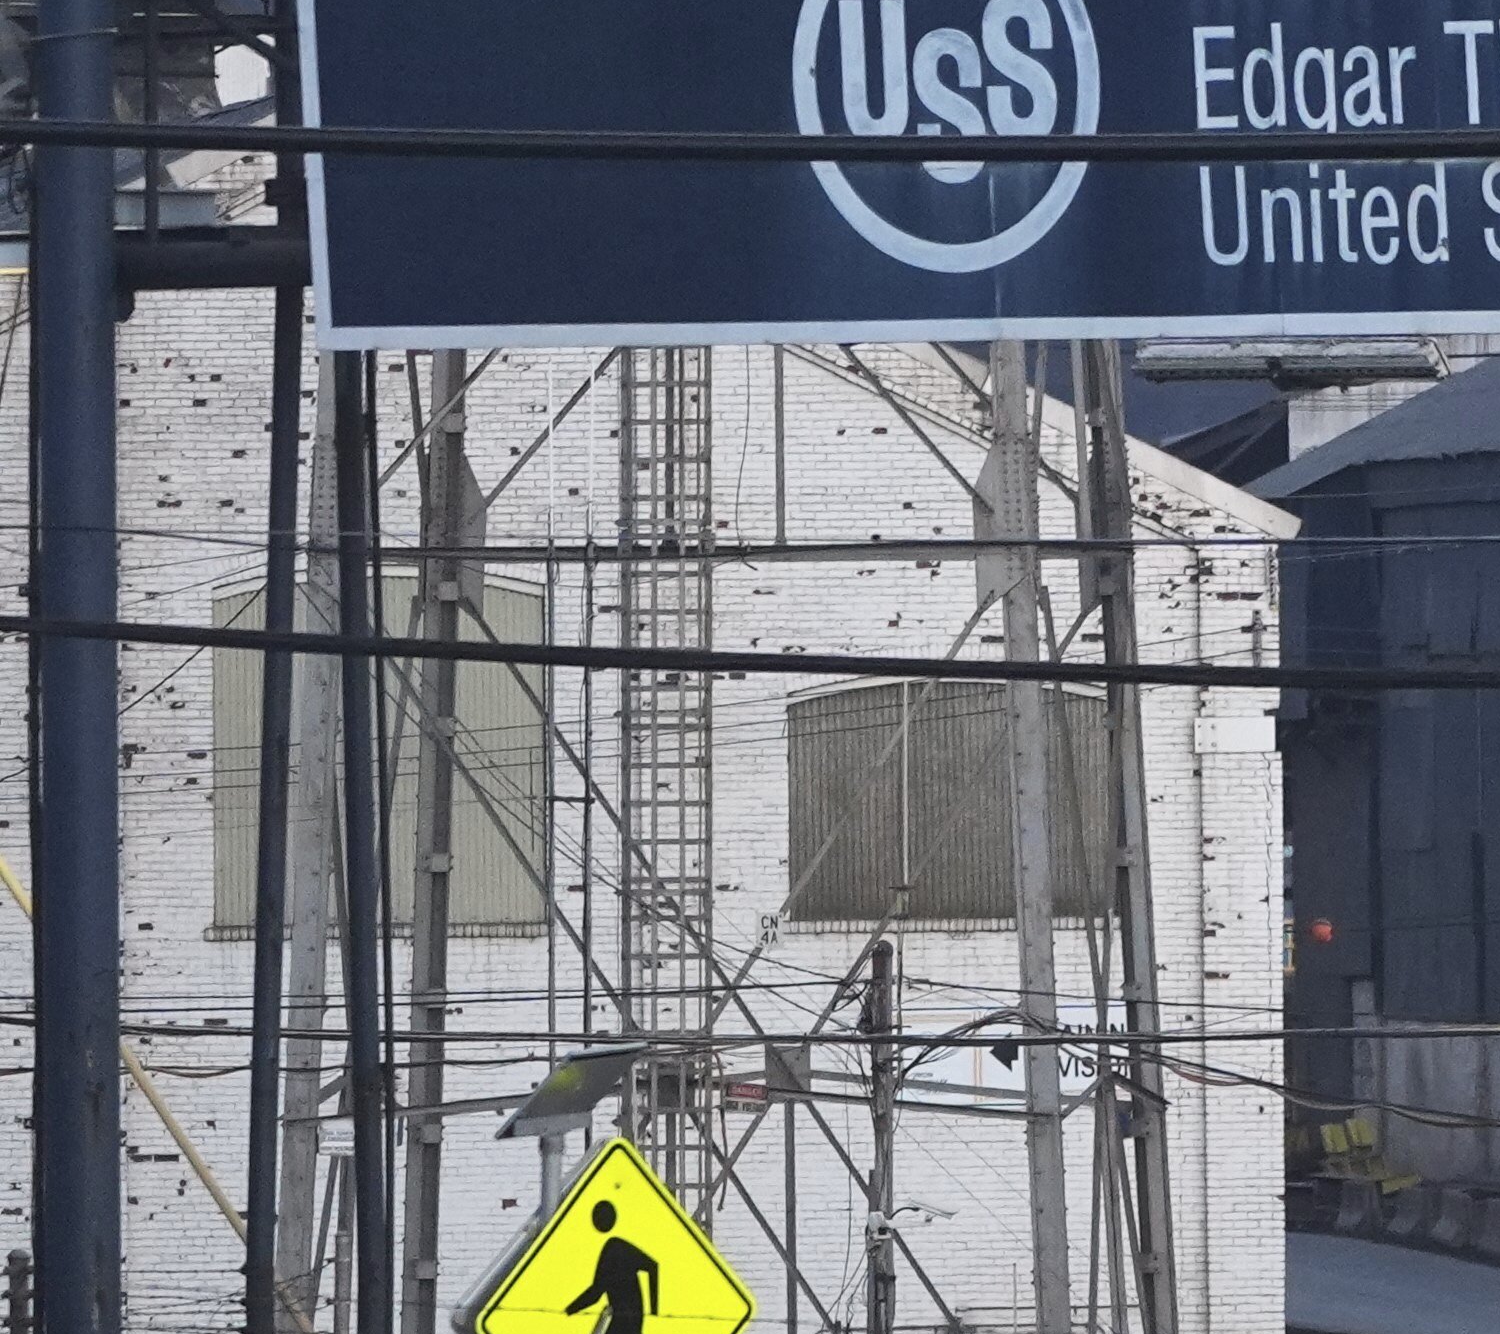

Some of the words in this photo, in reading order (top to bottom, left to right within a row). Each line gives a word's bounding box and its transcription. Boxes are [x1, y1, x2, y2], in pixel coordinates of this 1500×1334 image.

[1192, 22, 1417, 134] Edgar
[1199, 162, 1450, 267] United
[760, 930, 778, 944] 4A
[761, 915, 778, 929] CN
